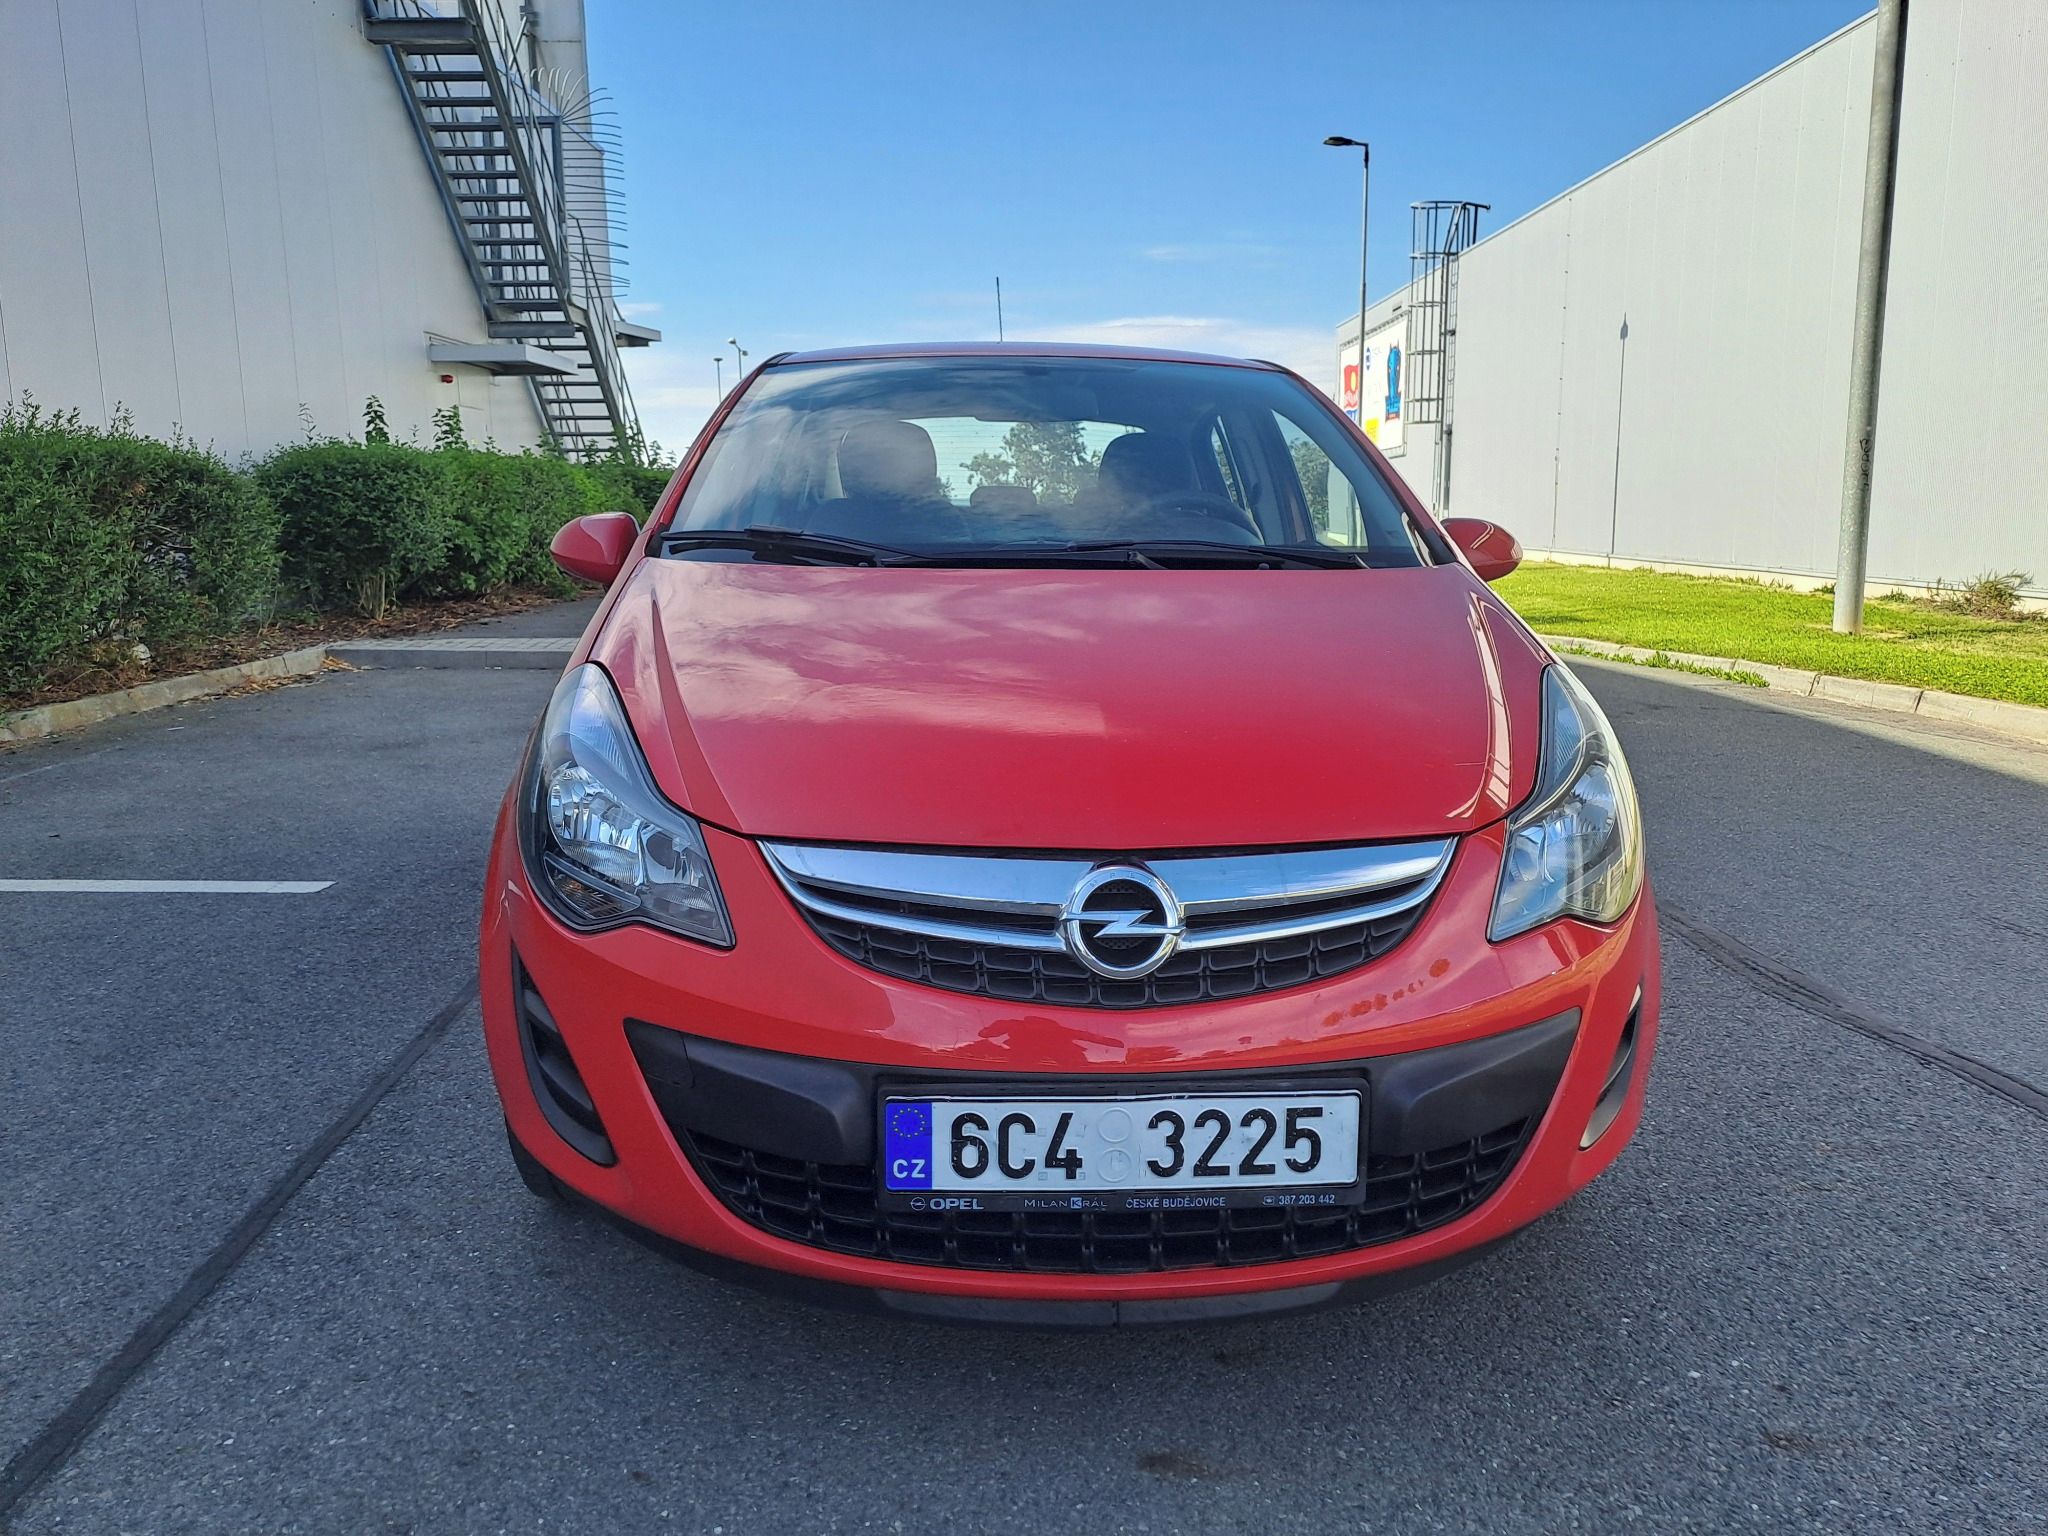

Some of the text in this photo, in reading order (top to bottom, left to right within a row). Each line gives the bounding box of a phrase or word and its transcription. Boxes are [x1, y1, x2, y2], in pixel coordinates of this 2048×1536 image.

[948, 1106, 1324, 1180] 6C4 3225
[892, 1158, 926, 1179] CZ
[930, 1198, 985, 1210] OPEL
[1125, 1196, 1226, 1209] ČESKÉ BUDĚJOVICE
[1278, 1194, 1335, 1205] 387 203 442
